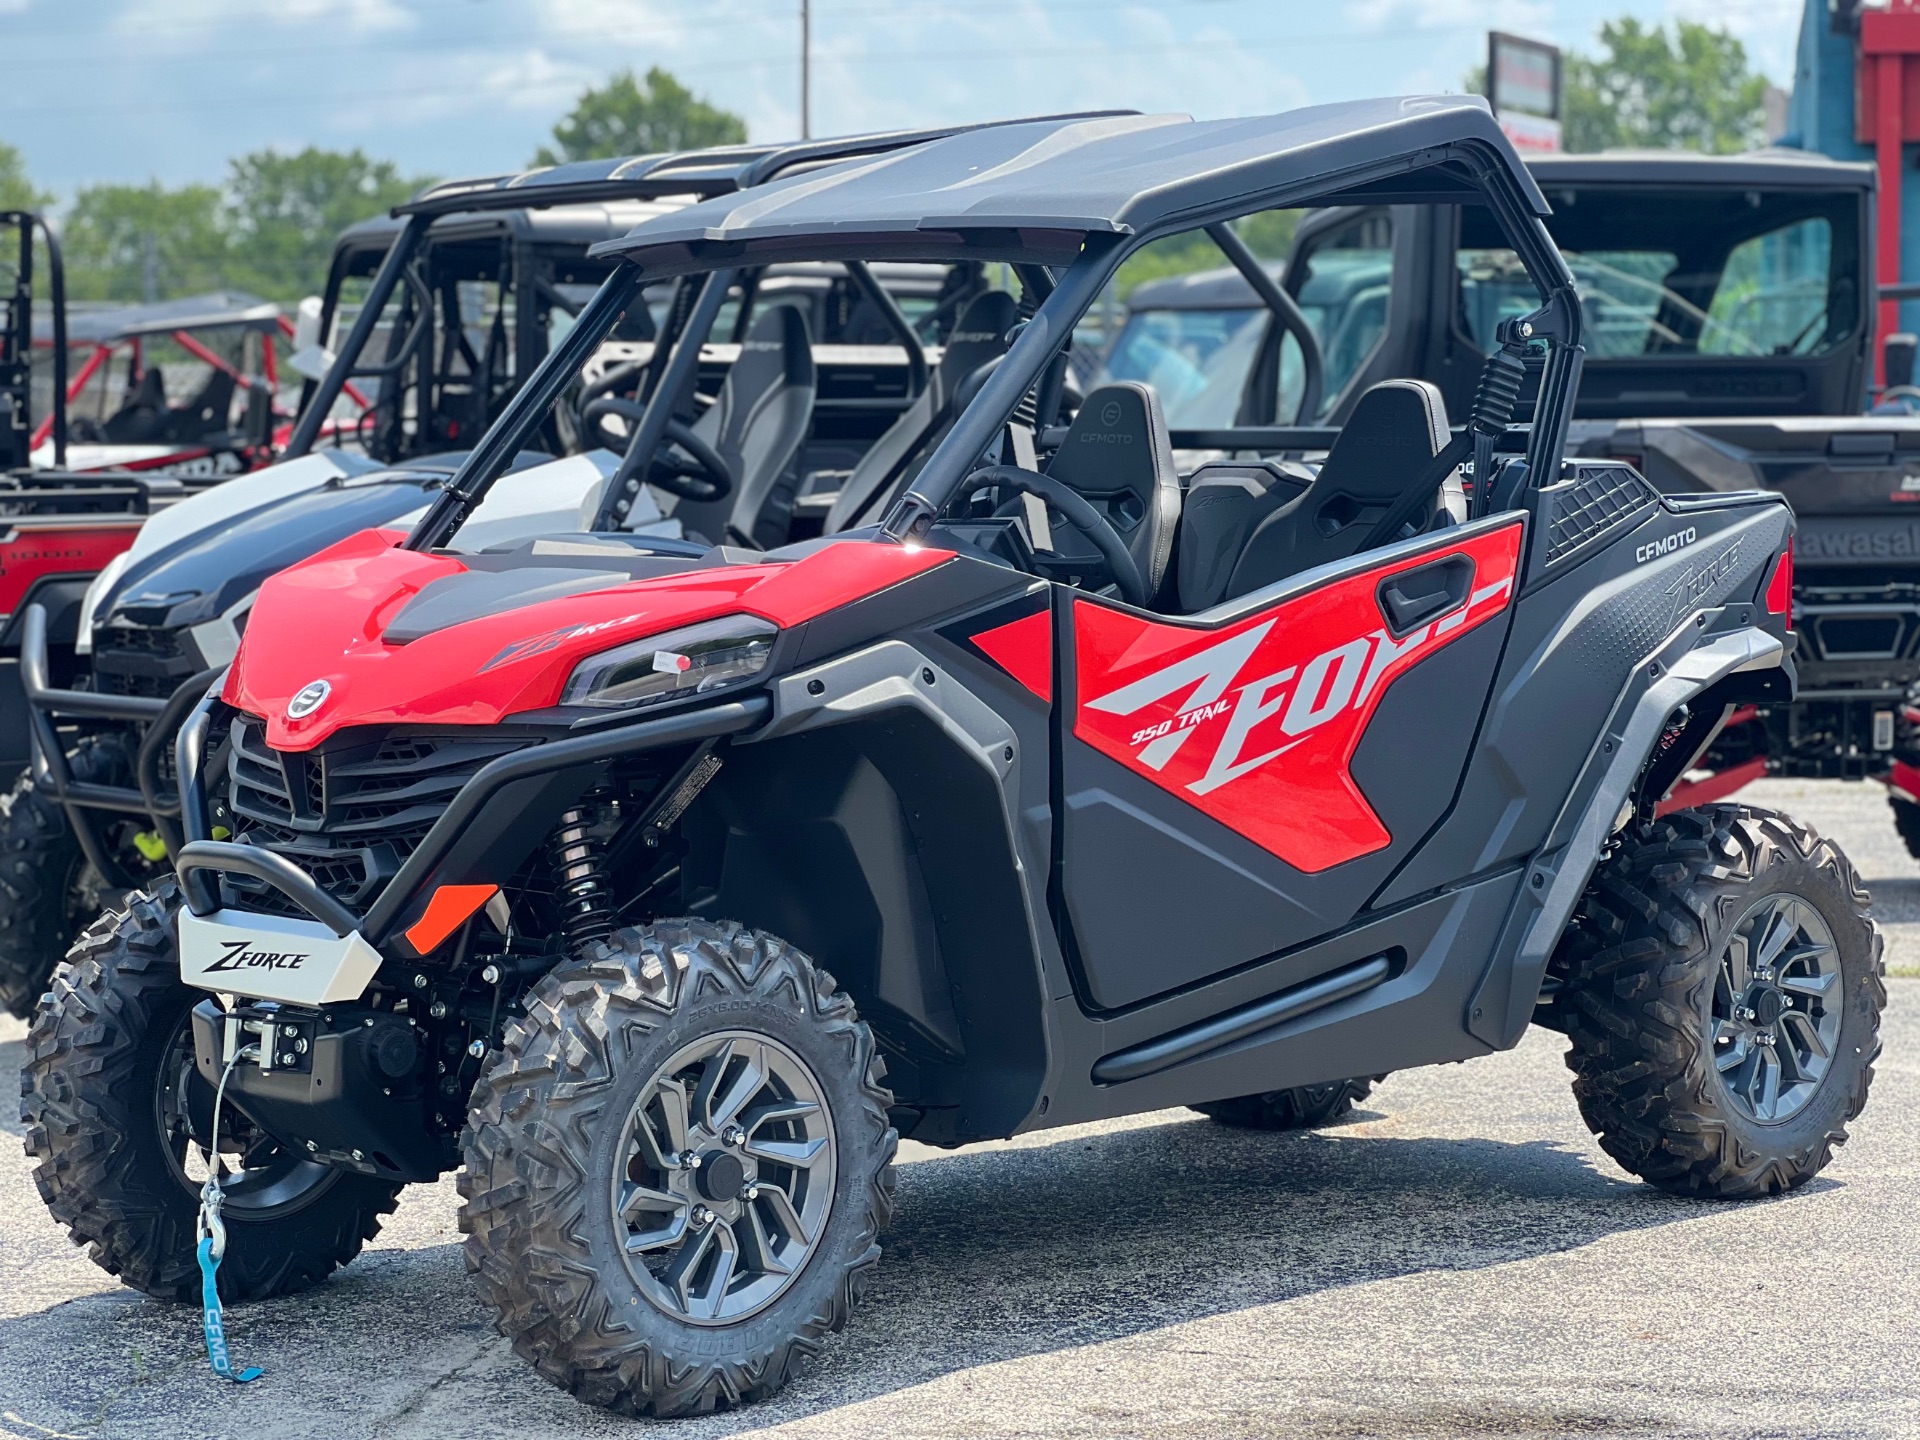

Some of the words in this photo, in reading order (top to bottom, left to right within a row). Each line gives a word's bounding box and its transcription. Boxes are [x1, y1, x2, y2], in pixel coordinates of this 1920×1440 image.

[1080, 433, 1133, 445] CFMOTO
[1635, 526, 1697, 563] CFMOTO
[1793, 522, 1920, 558] awasa
[1083, 581, 1511, 797] ZFO
[1129, 719, 1173, 746] 950
[1178, 699, 1232, 729] TRAIL
[201, 941, 311, 974] ZFORCE
[207, 1308, 230, 1374] CFMO
